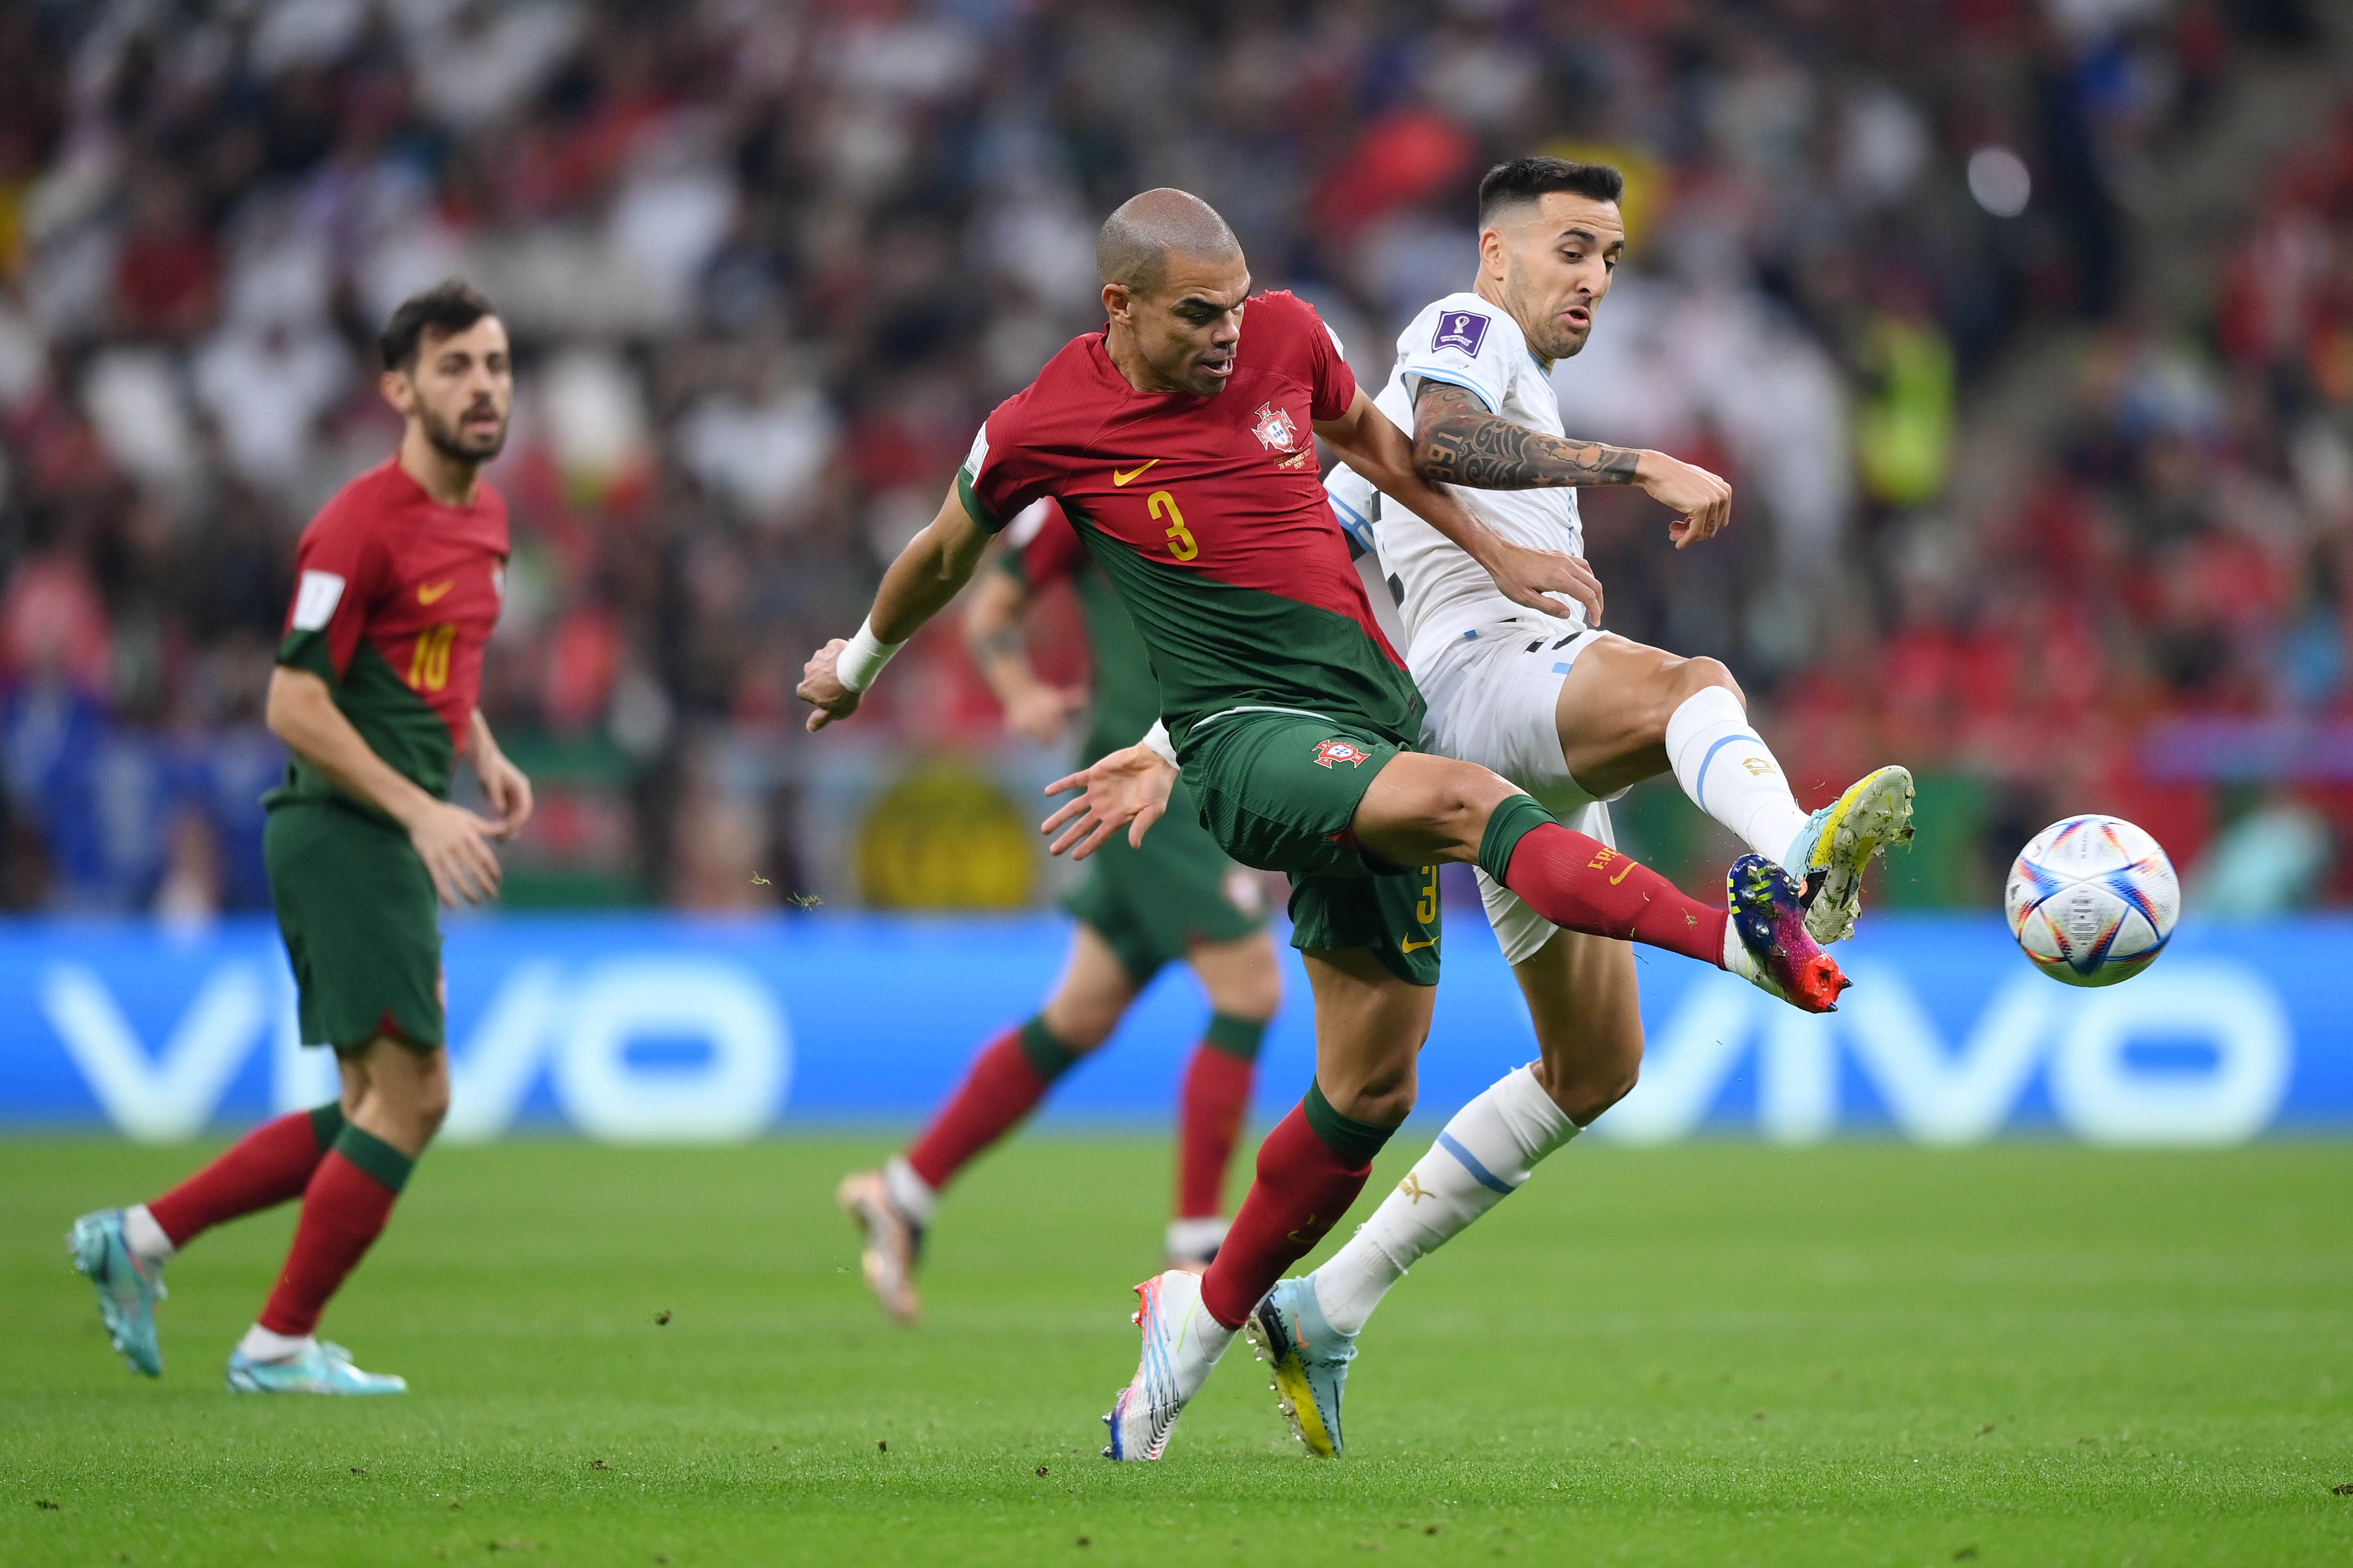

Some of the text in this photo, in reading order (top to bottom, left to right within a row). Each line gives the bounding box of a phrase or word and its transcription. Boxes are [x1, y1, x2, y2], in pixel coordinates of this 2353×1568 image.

[1147, 491, 1199, 561] 3
[409, 623, 457, 692] 10
[1416, 865, 1437, 924] 3
